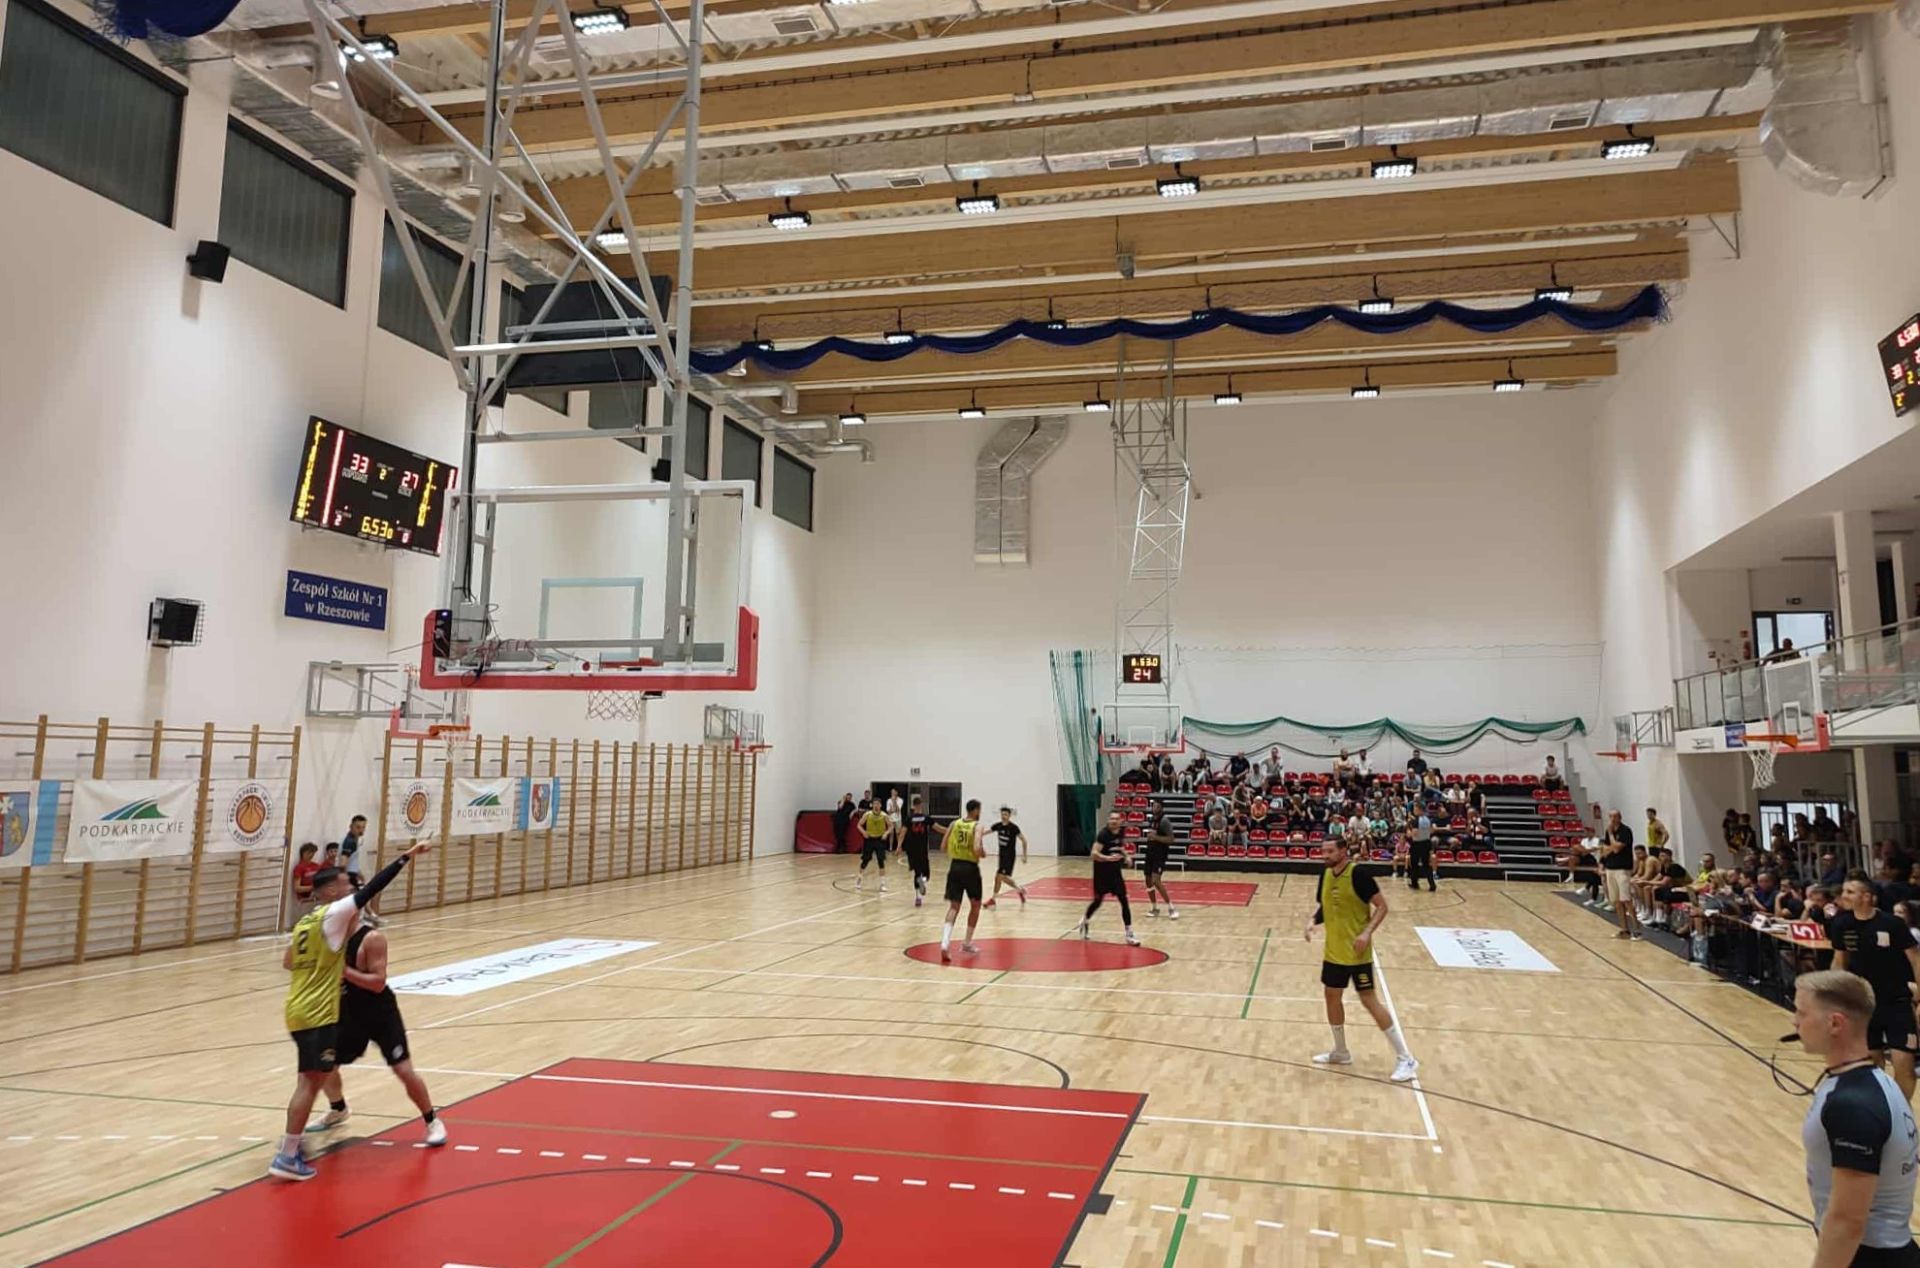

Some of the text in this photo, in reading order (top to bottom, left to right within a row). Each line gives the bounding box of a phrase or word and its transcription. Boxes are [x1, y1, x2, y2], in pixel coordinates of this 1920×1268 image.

[350, 454, 369, 473] 33
[379, 469, 388, 480] 2
[402, 471, 419, 489] 27
[334, 514, 342, 526] 2
[292, 578, 382, 606] Zespół Szkół Nr 1
[305, 602, 370, 622] w Rzeszowie
[1134, 668, 1151, 680] 24
[79, 821, 184, 838] PODKARPACKIE
[959, 830, 968, 843] 31
[297, 929, 309, 954] 2
